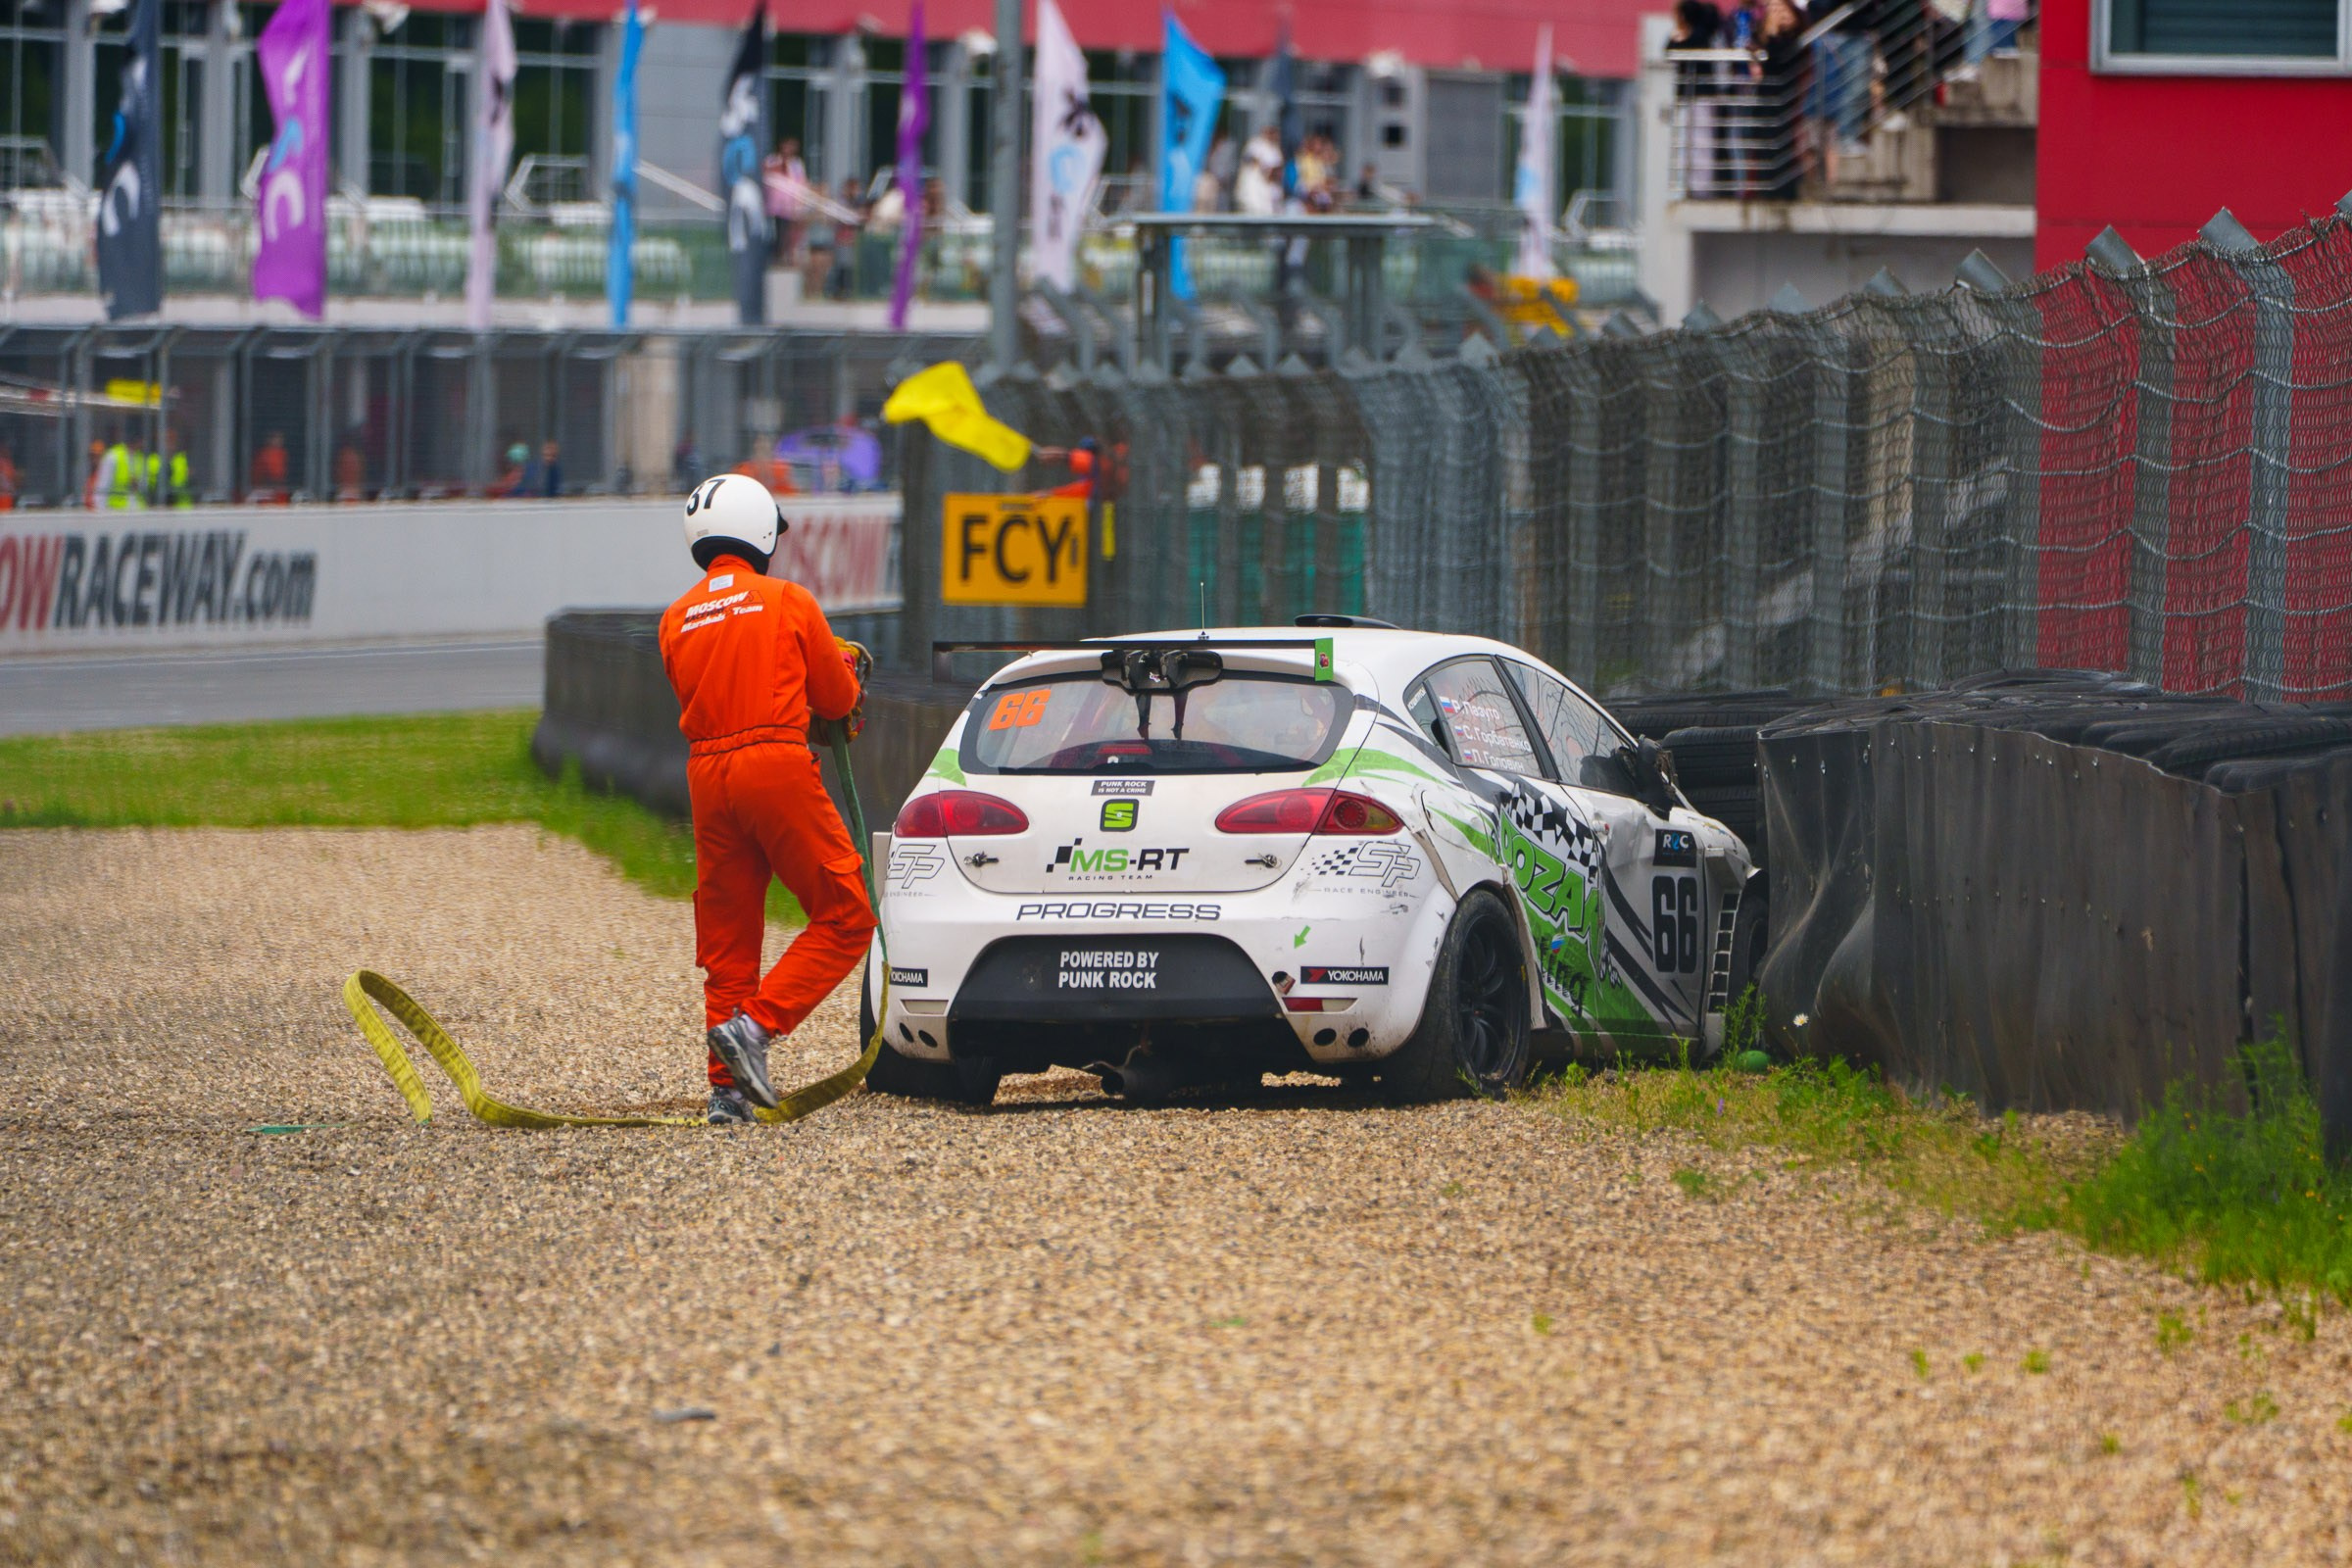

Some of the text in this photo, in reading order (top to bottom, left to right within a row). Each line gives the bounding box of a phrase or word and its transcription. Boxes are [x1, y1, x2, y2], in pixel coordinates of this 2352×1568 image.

[960, 514, 1070, 583] FCY
[687, 591, 749, 617] MOSCOW
[732, 605, 763, 615] Team
[988, 689, 1052, 730] 66
[1070, 848, 1190, 872] MS-RT
[1016, 903, 1221, 921] PROGRESS
[1652, 876, 1697, 974] 66
[1059, 951, 1159, 968] POWERED BY
[1058, 971, 1157, 989] PUNK ROCK
[1327, 970, 1385, 982] YOKOHAMA
